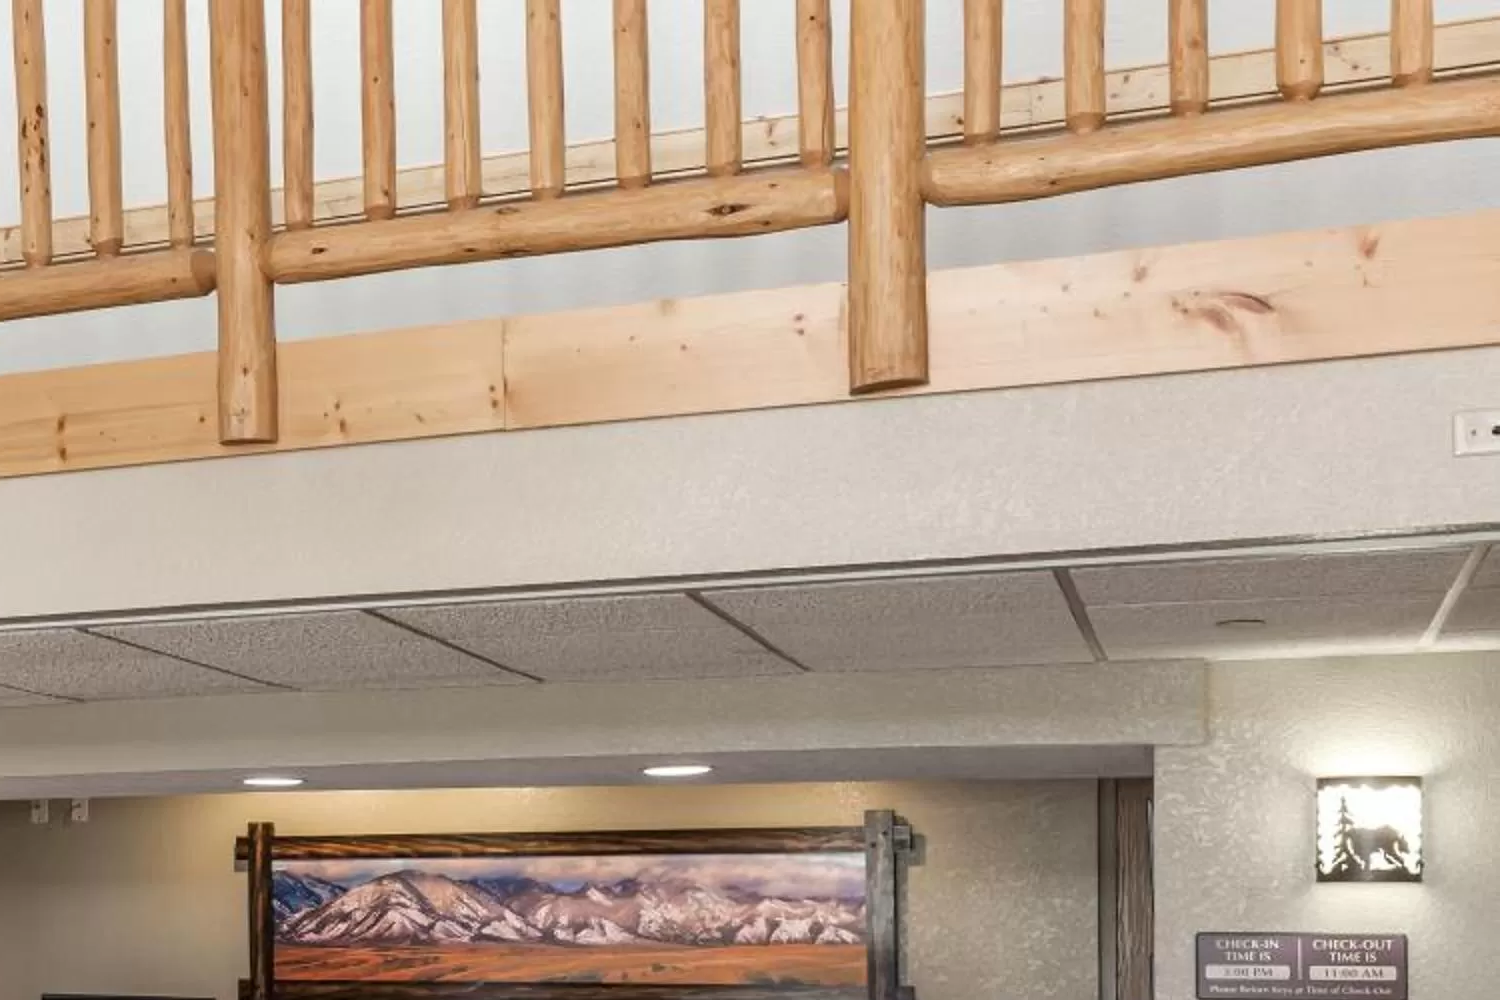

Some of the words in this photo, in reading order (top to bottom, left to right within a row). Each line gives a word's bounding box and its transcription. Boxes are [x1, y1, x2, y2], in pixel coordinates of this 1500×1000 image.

[1215, 939, 1280, 950] CHECK-IN
[1312, 939, 1394, 951] CHECK-OUT
[1223, 951, 1255, 961] TIME
[1259, 951, 1272, 962] IS
[1329, 951, 1361, 963] TIME
[1365, 952, 1377, 963] IS
[1362, 968, 1385, 978] AM
